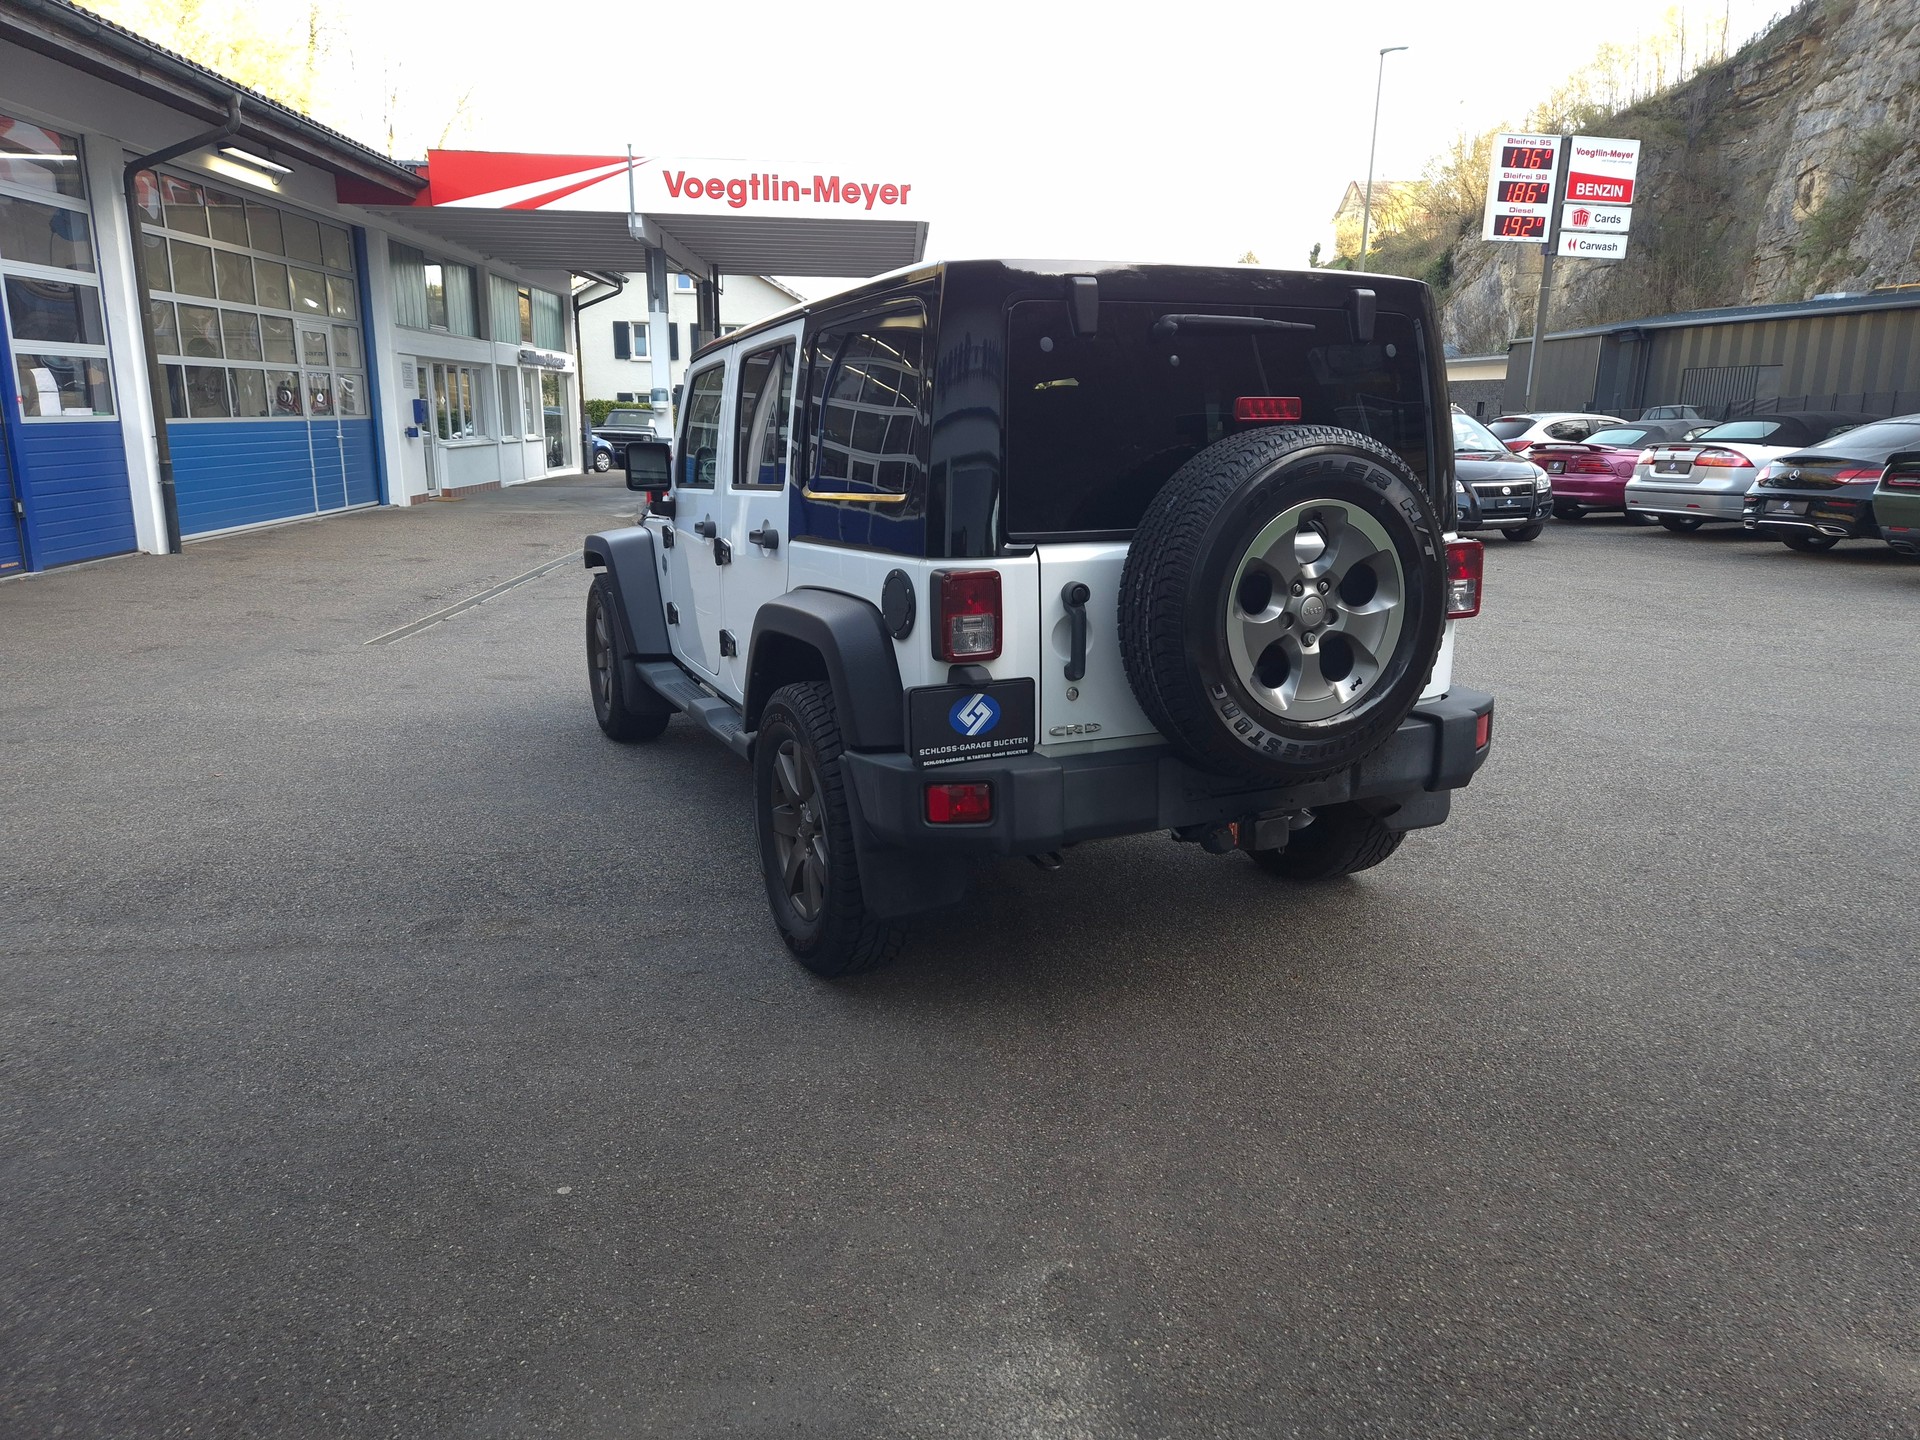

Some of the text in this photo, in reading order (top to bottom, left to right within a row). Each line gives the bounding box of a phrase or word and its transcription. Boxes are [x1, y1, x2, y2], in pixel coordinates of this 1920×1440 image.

[1507, 137, 1552, 147] Bleifrei 95
[1576, 147, 1634, 160] Voegtlin-Meyer
[1503, 172, 1548, 181] Bleifrei 98
[662, 170, 912, 210] Voegtlin-Meyer
[1575, 182, 1624, 198] BENZIN
[1508, 206, 1534, 214] Diesel
[1594, 213, 1621, 224] Cards
[1579, 240, 1618, 252] Carwash
[1049, 723, 1102, 737] CRD
[919, 736, 1029, 756] SCHLOSS-GARAGE BUCKTEN
